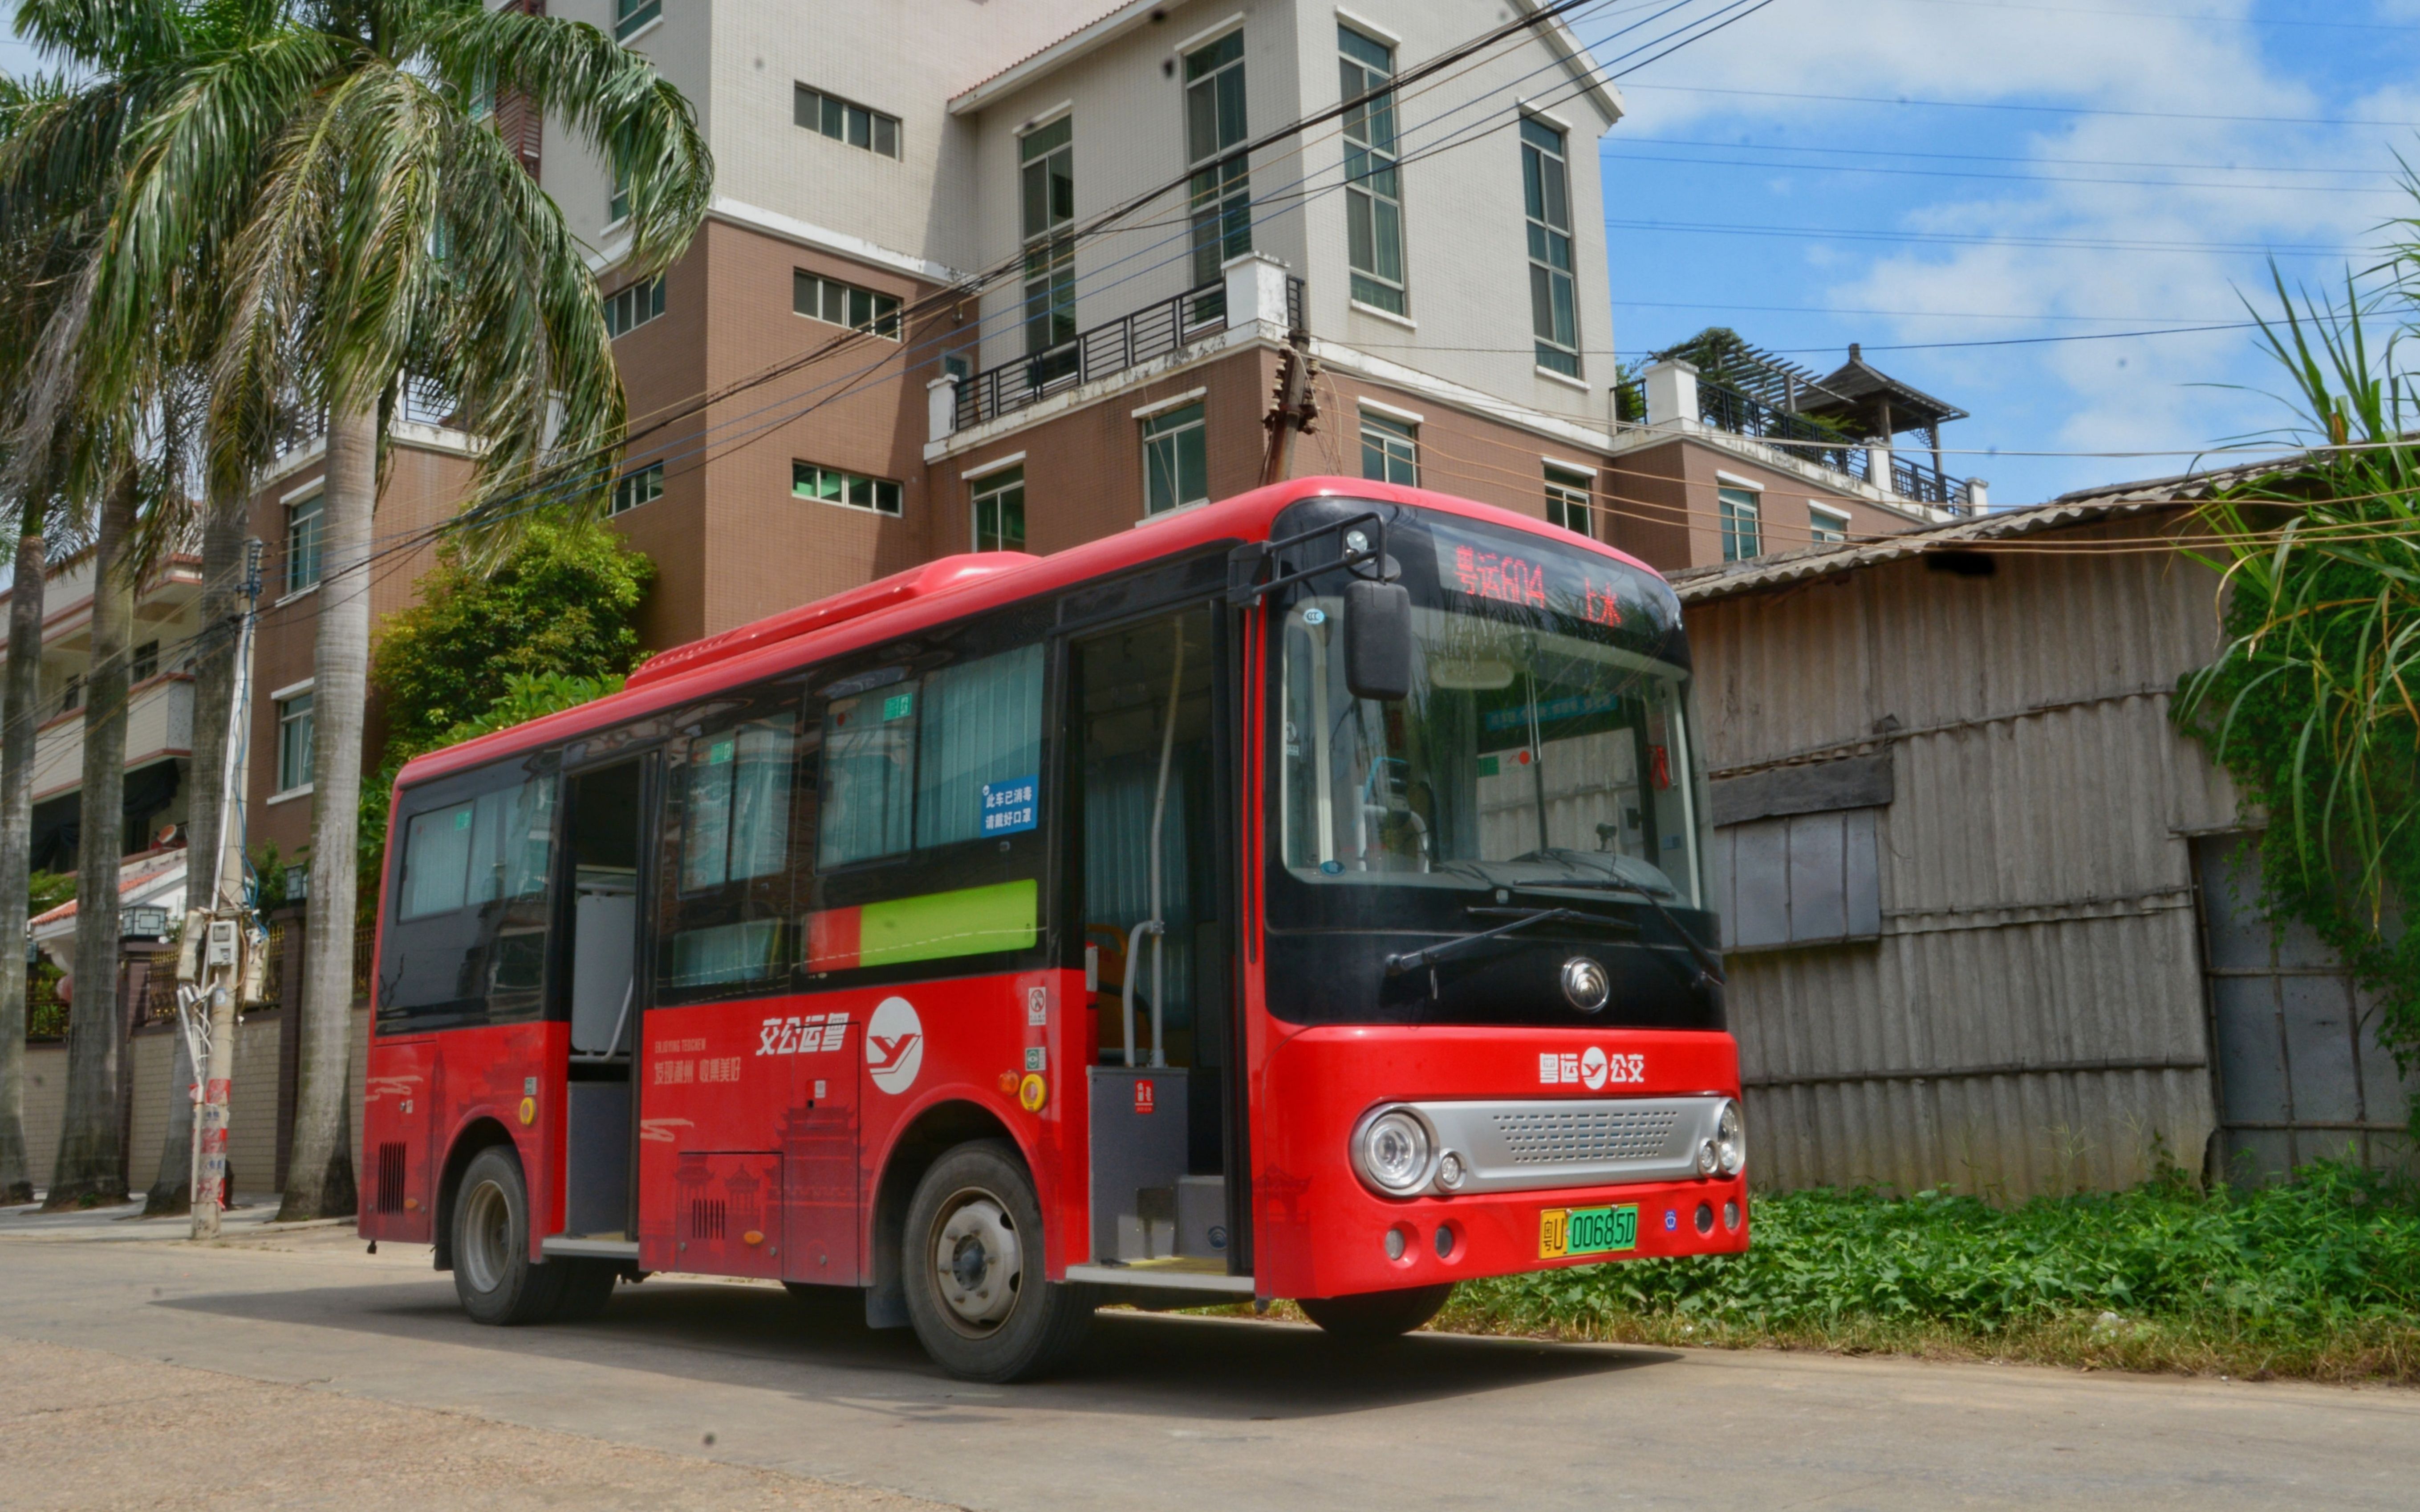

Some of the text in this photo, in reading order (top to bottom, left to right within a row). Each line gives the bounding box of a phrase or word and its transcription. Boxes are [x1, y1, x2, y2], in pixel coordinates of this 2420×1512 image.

[986, 786, 1032, 808] 此车已消毒
[985, 808, 1031, 830] 请戴好口罩
[1539, 1053, 1644, 1084] 粤运 公交
